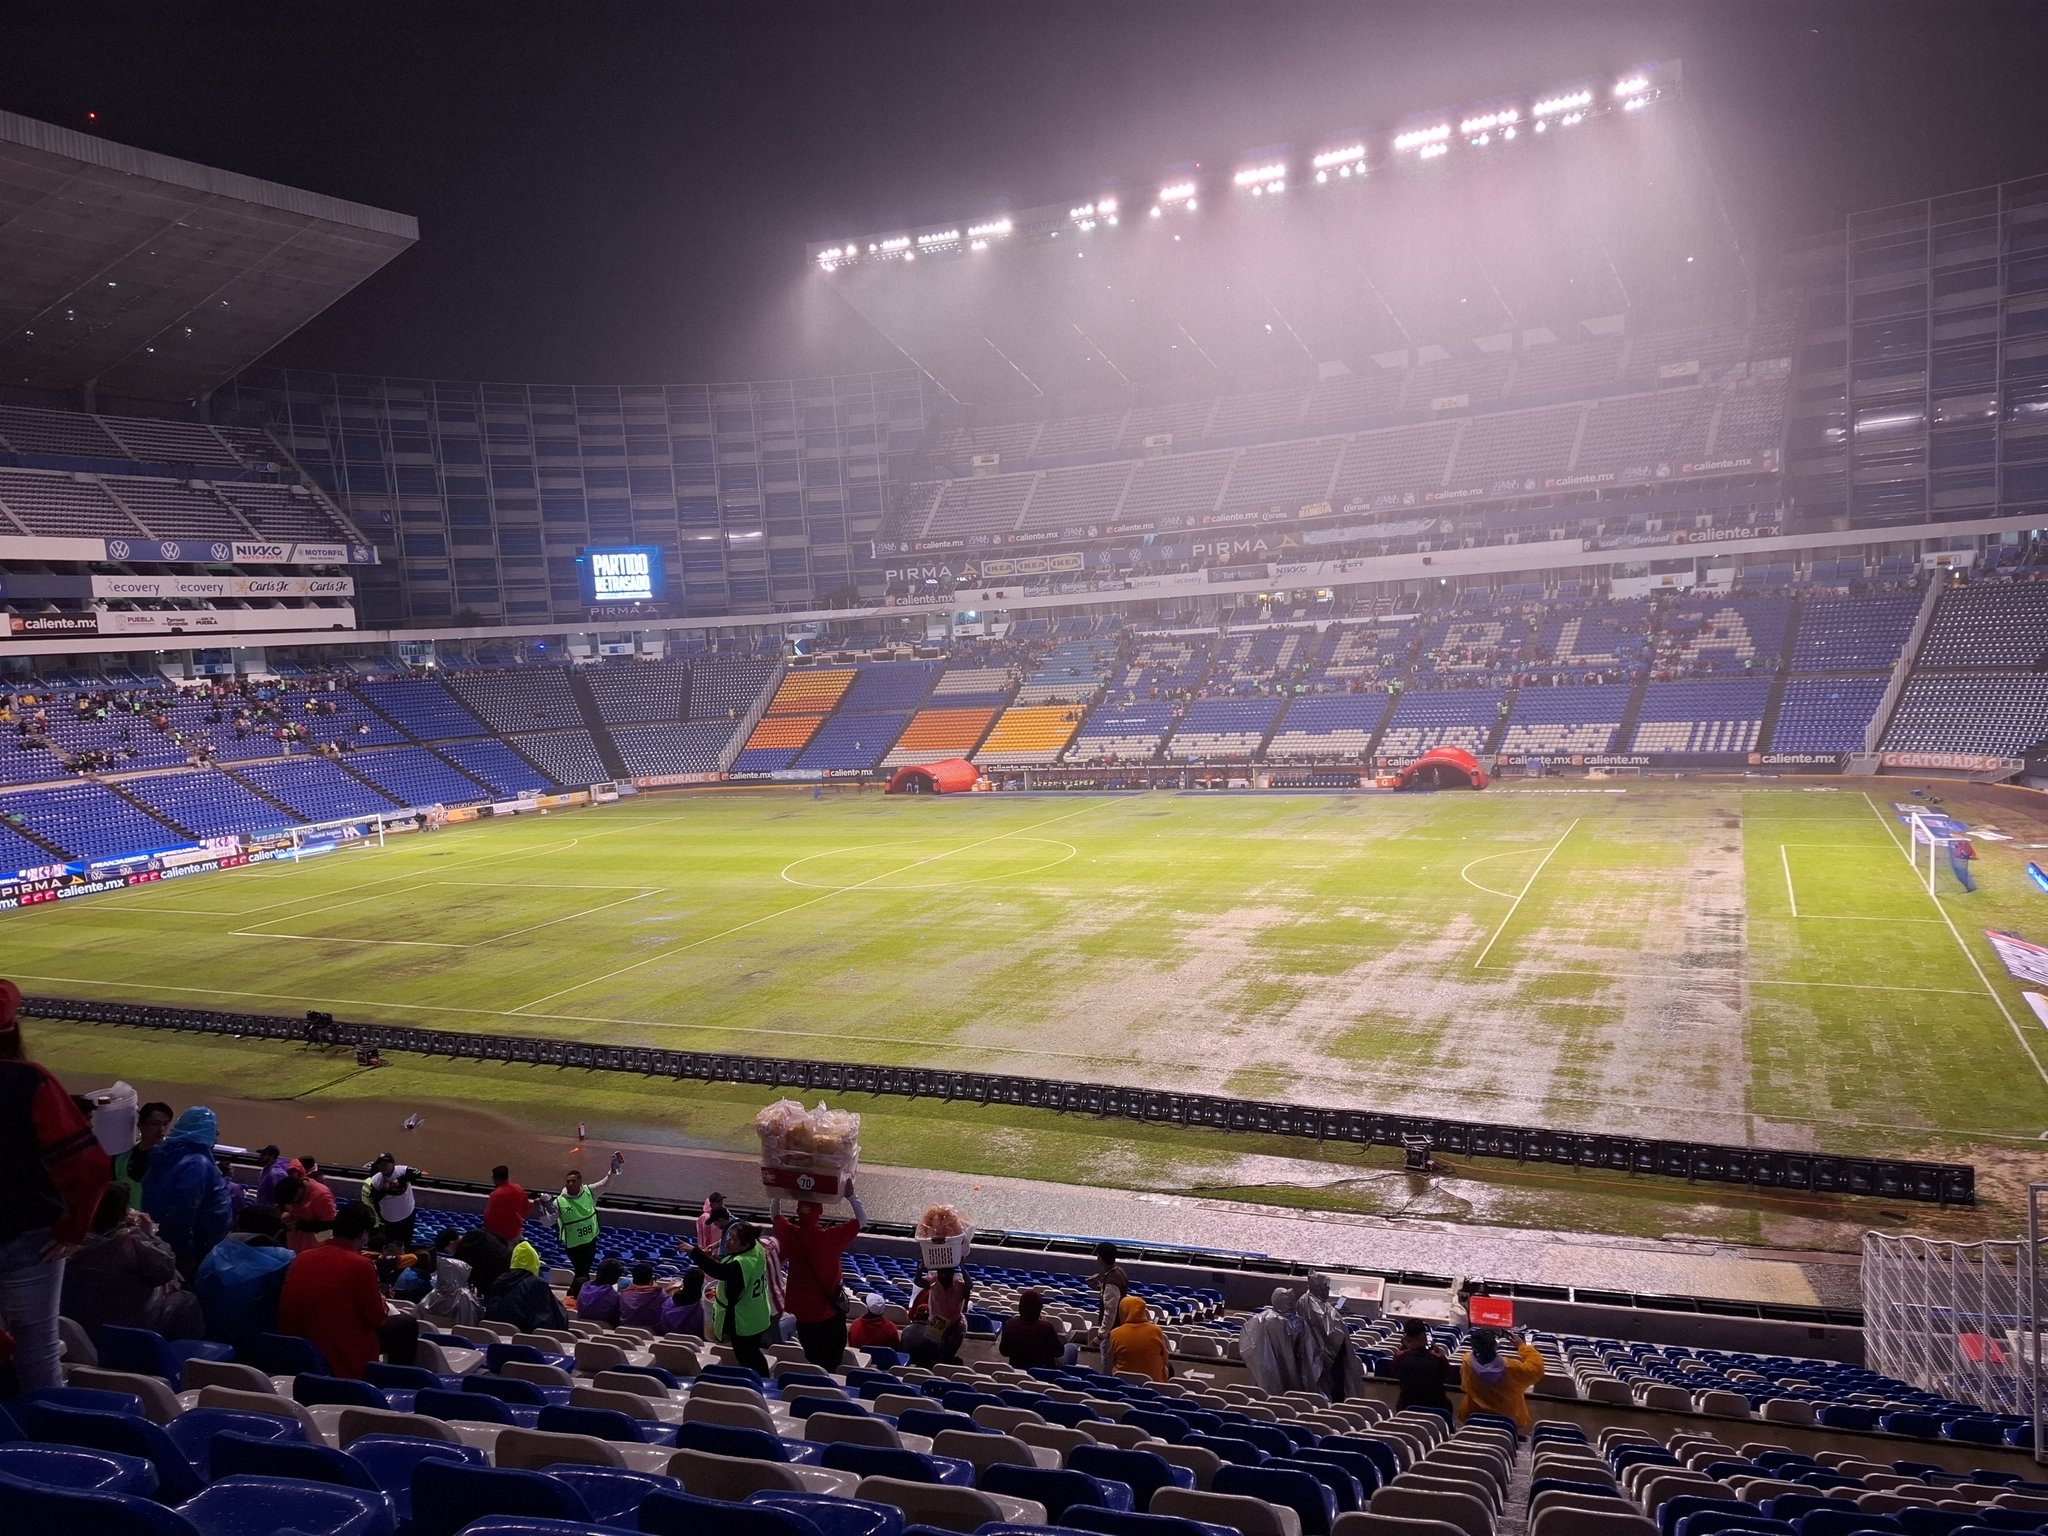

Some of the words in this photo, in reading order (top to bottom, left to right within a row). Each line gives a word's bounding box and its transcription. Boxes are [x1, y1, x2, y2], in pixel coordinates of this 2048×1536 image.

[1693, 458, 1752, 471] caliente.mx
[1556, 473, 1615, 486] caliente.mx
[1434, 488, 1484, 500] caliente.mx
[1212, 512, 1259, 523] caliente.mx
[1113, 522, 1155, 533] caliente.mx
[1016, 531, 1059, 542] caliente.mx
[922, 540, 964, 550] caliente.mx
[1192, 539, 1268, 557] PIRMA
[305, 549, 345, 557] MOTORFIL
[592, 553, 649, 576] PARTIDO
[988, 564, 1014, 573] IKEA
[1019, 561, 1045, 570] IKEA
[1052, 558, 1079, 566] IKEA
[886, 566, 952, 581] PIRMA
[897, 593, 955, 606] caliente.mx
[590, 606, 641, 616] PIRMA
[25, 618, 97, 630] caliente.mx
[1584, 755, 1649, 765] caliente.mx
[1762, 753, 1836, 765] caliente.mx
[1899, 754, 1983, 767] GATORADE
[729, 772, 772, 780] caliente.mx
[830, 769, 874, 777] calientemx
[649, 774, 705, 785] GATORADE
[160, 861, 219, 879] caliente.mx
[2, 879, 62, 897] PIRMA
[57, 879, 125, 899] caliente.mx
[800, 1178, 811, 1189] 70
[576, 1224, 593, 1238] 388
